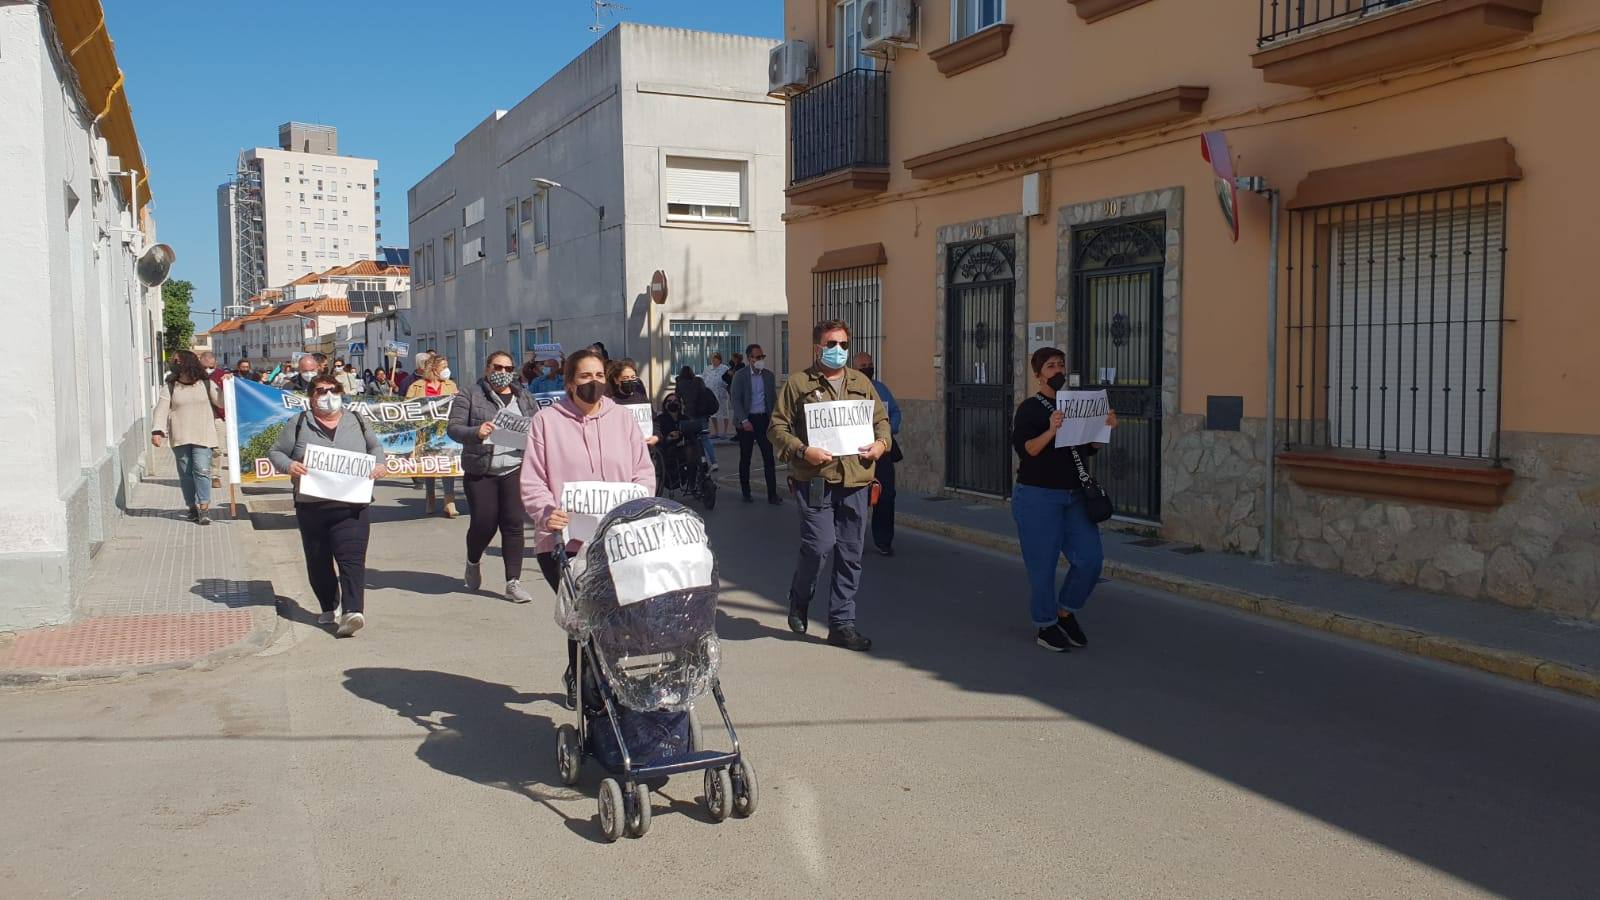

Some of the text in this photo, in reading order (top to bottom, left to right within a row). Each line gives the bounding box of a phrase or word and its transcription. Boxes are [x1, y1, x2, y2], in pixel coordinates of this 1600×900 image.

[380, 401, 425, 421] DE
[808, 402, 872, 429] LEGALIZACIÓN
[305, 449, 374, 478] LEGALIZACIÓN
[420, 456, 452, 474] DE
